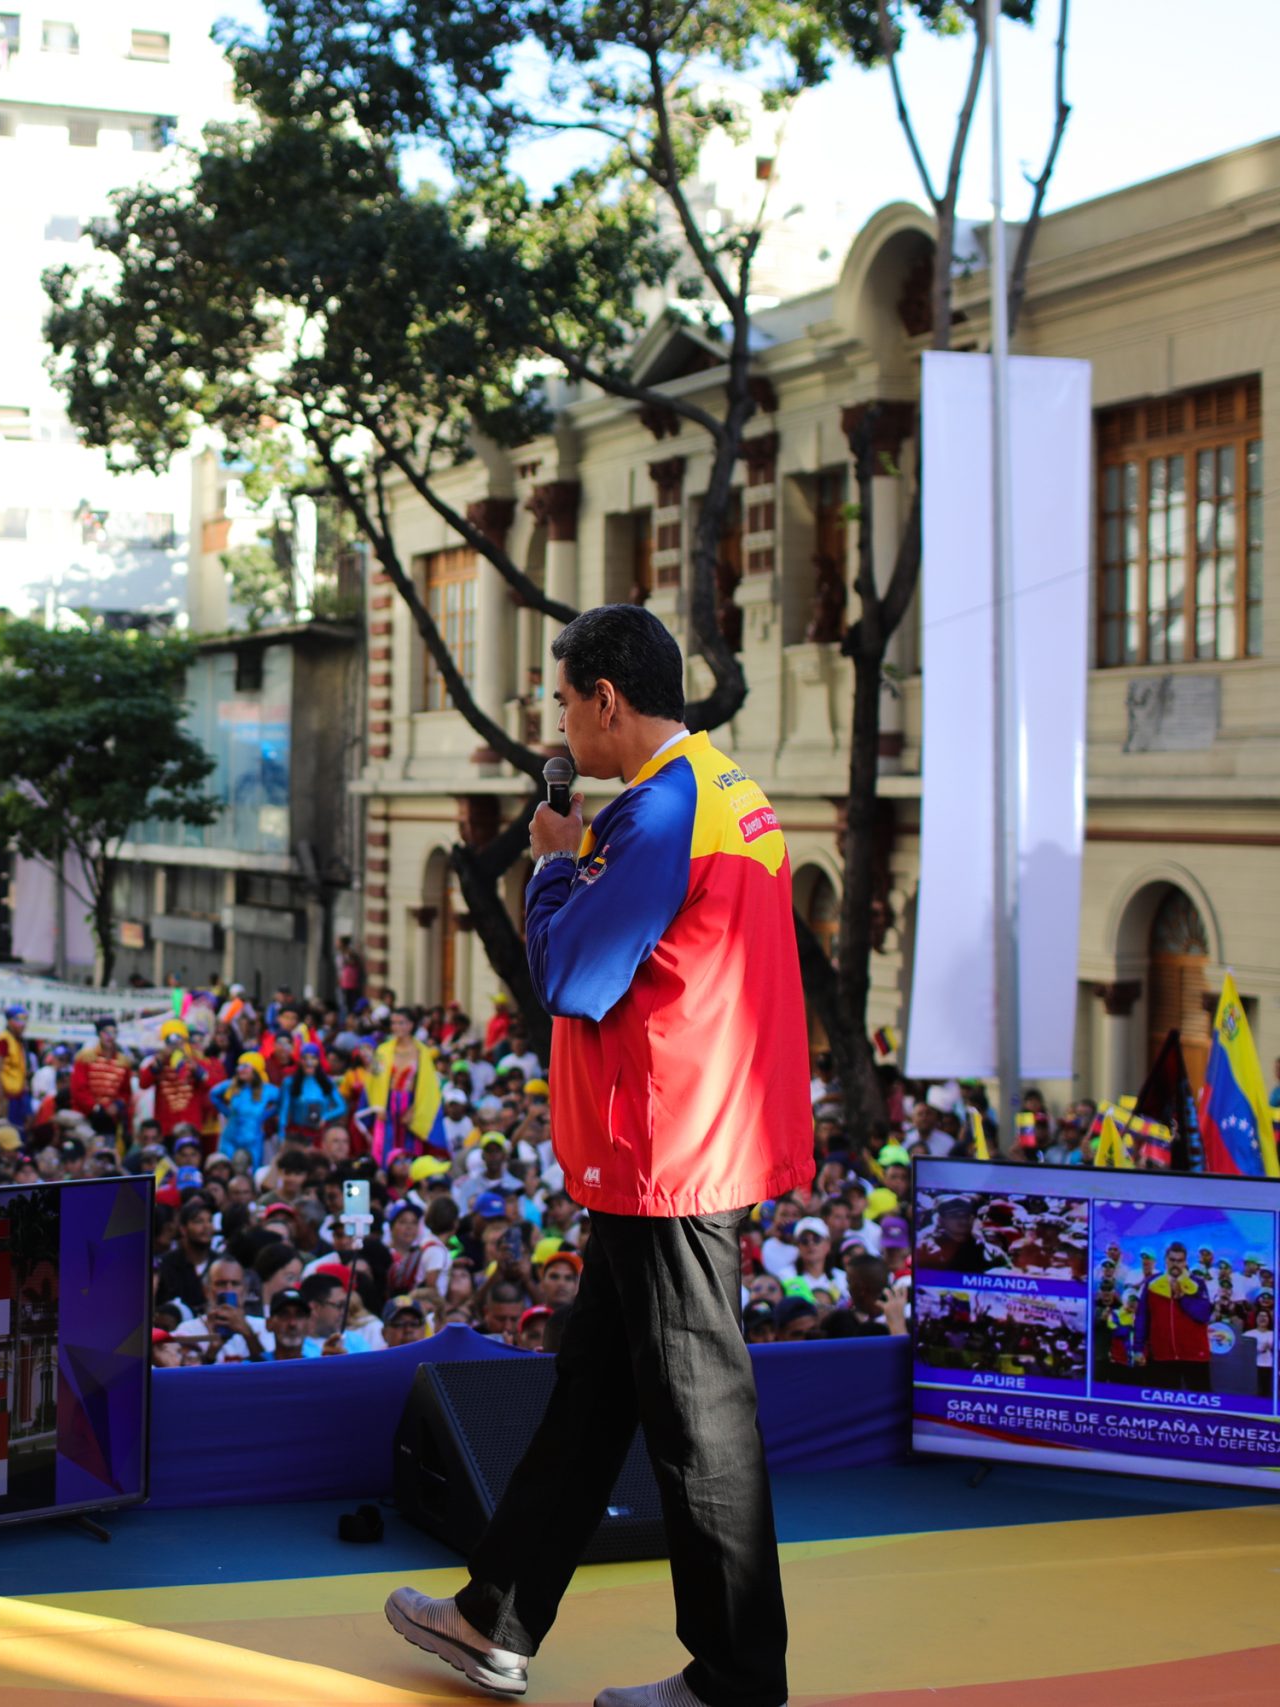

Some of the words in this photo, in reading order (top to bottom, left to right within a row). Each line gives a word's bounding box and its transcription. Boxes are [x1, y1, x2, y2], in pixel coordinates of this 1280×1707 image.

[962, 1275, 1039, 1292] MIRANDA
[972, 1374, 1026, 1389] APURE
[1140, 1389, 1222, 1408] CARACAS
[947, 1400, 998, 1414] GRAN
[1004, 1405, 1070, 1421] CIERRE
[1075, 1411, 1099, 1424] DE
[1105, 1414, 1201, 1434] CAMPAÑA
[947, 1411, 975, 1423] POR
[979, 1413, 996, 1425] EL
[1098, 1426, 1190, 1444] CONSULTIVO
[1195, 1435, 1214, 1447] EN
